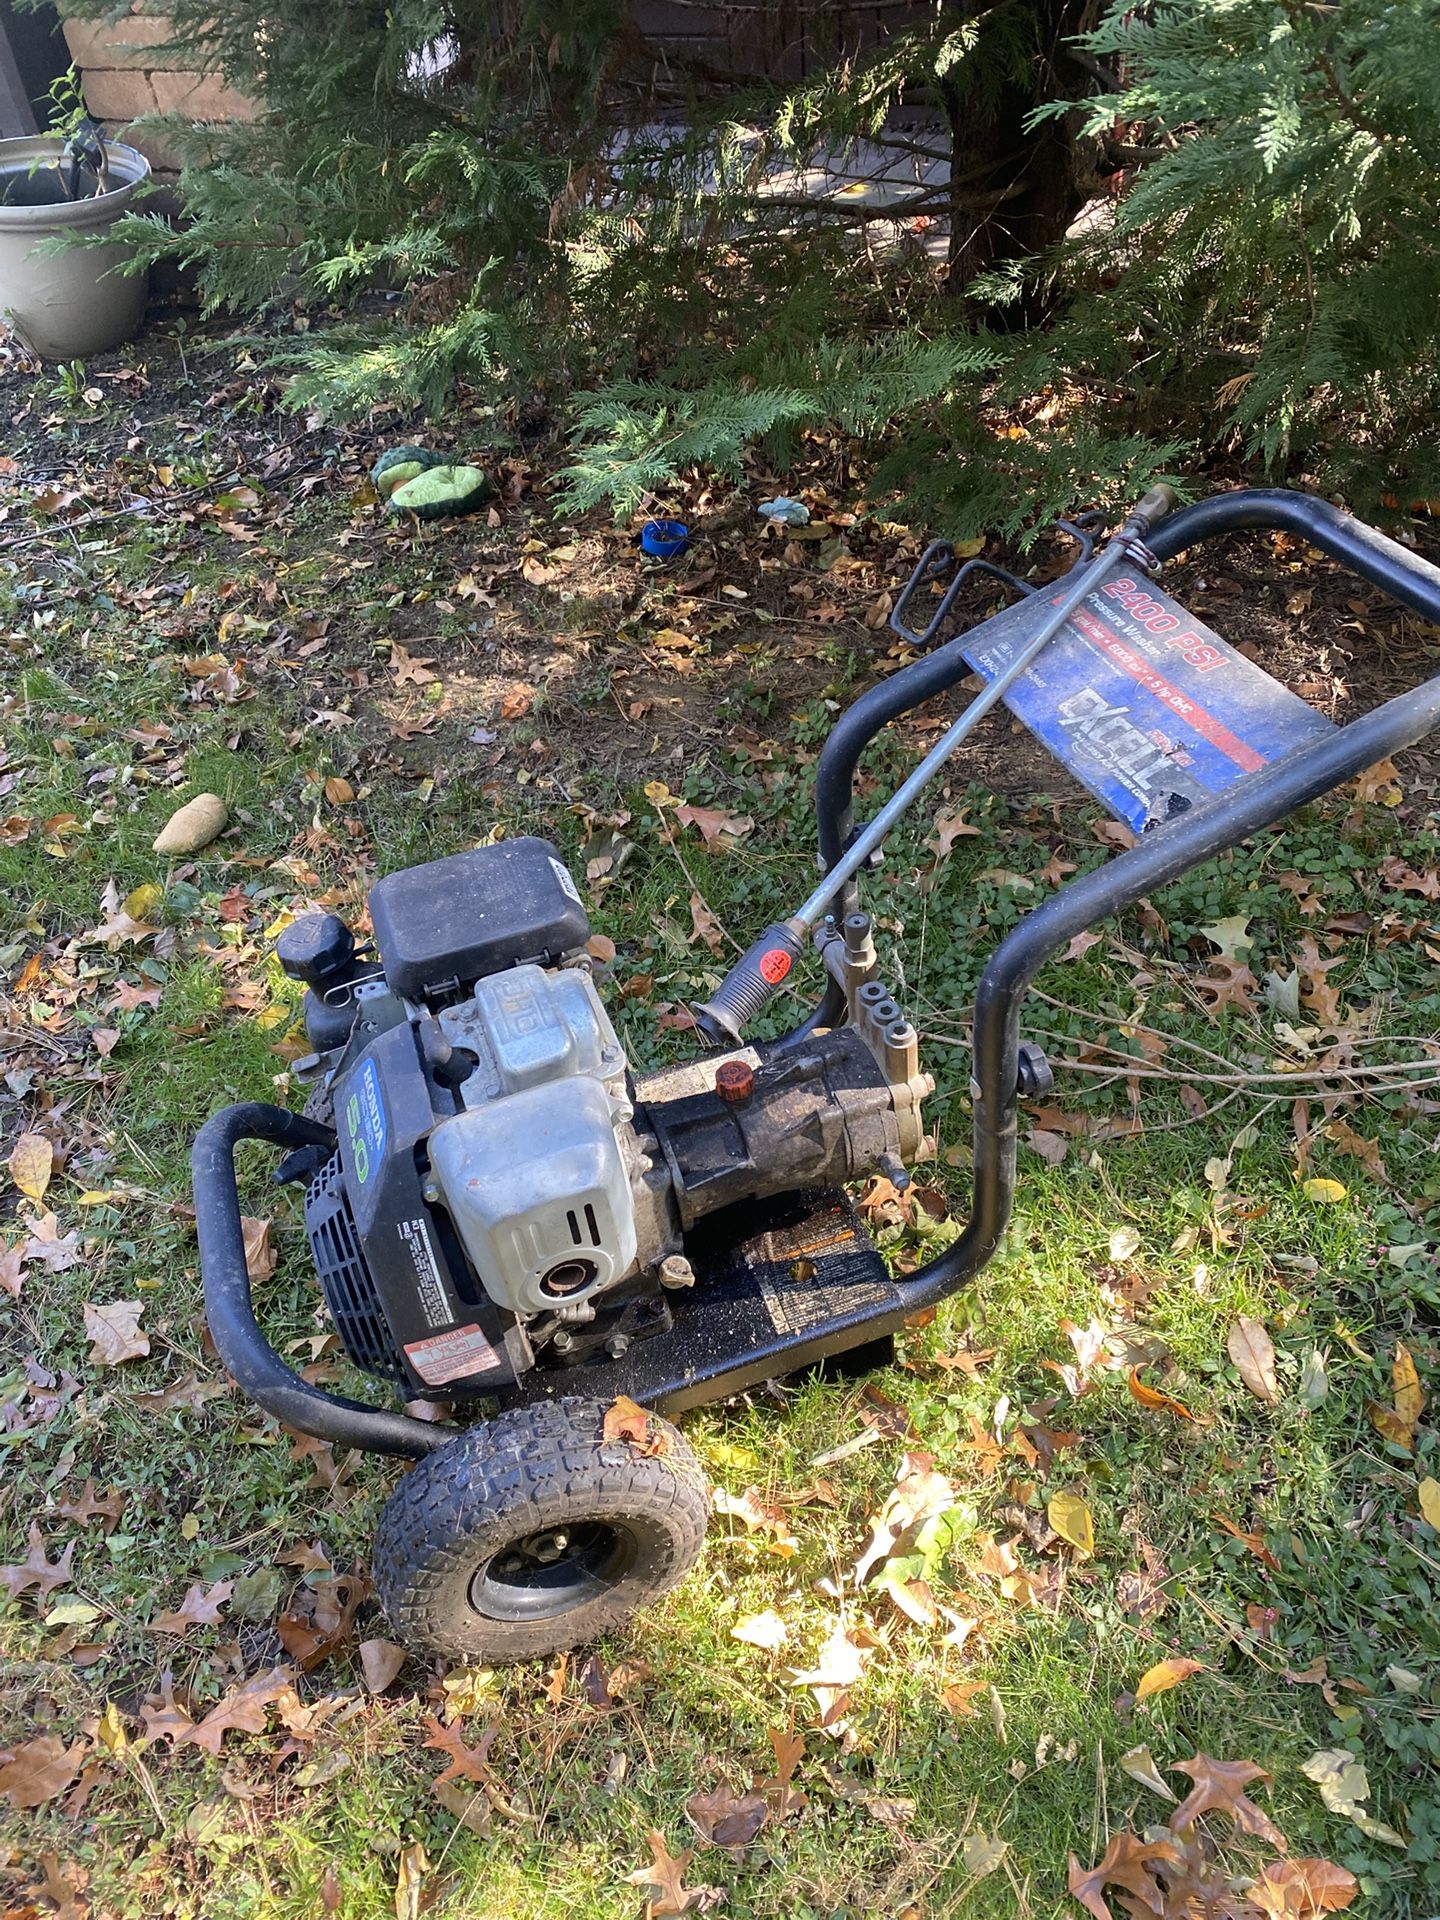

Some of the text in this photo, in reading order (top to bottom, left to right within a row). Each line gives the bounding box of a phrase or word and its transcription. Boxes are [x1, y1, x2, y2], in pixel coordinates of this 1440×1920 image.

[1087, 591, 1125, 627] Pressure
[1122, 623, 1162, 656] Washer
[1101, 578, 1180, 634] 2400
[1164, 631, 1231, 673] PSI
[1108, 643, 1135, 663] 6000
[1150, 680, 1163, 689] 5
[1169, 696, 1194, 714] OHC
[1057, 686, 1175, 791] EXCELL
[1110, 767, 1137, 790] POWER
[346, 1093, 369, 1184] 5.0
[363, 1064, 384, 1151] HONDA
[427, 1329, 467, 1347] DANGER
